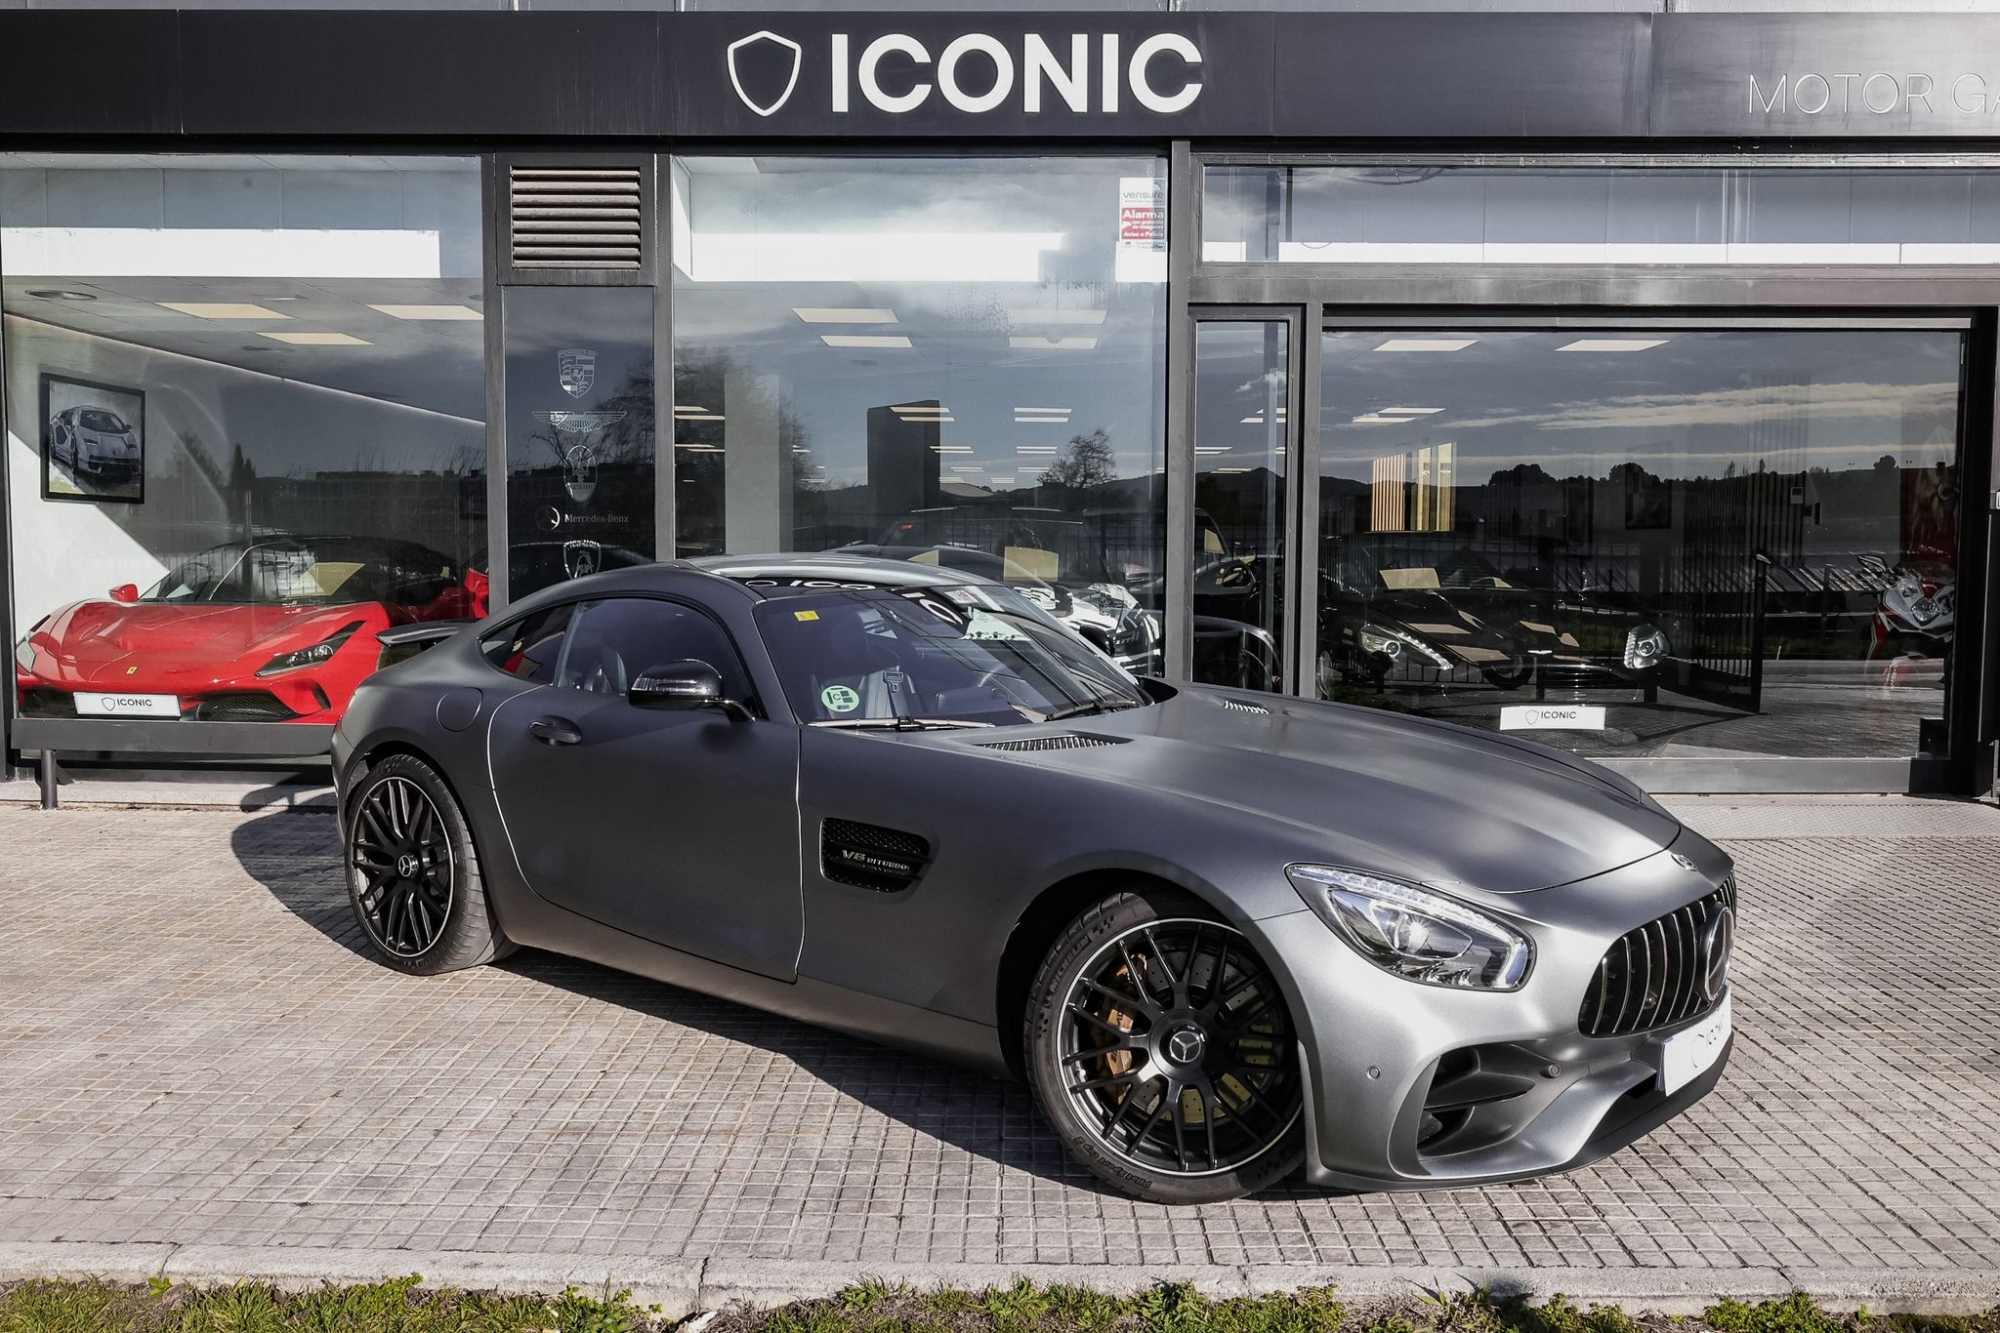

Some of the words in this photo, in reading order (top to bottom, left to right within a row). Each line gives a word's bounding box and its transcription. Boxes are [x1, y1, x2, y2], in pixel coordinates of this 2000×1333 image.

[831, 33, 1203, 113] ICONIC
[1748, 72, 1934, 114] MOTOR
[1951, 73, 2000, 114] G
[1122, 209, 1164, 219] Alarma
[564, 513, 629, 524] Mercedes-Benz
[116, 698, 153, 707] ICONIC
[1540, 710, 1577, 719] ICONIC
[842, 849, 866, 861] V8
[1048, 934, 1093, 994] MICHELIN
